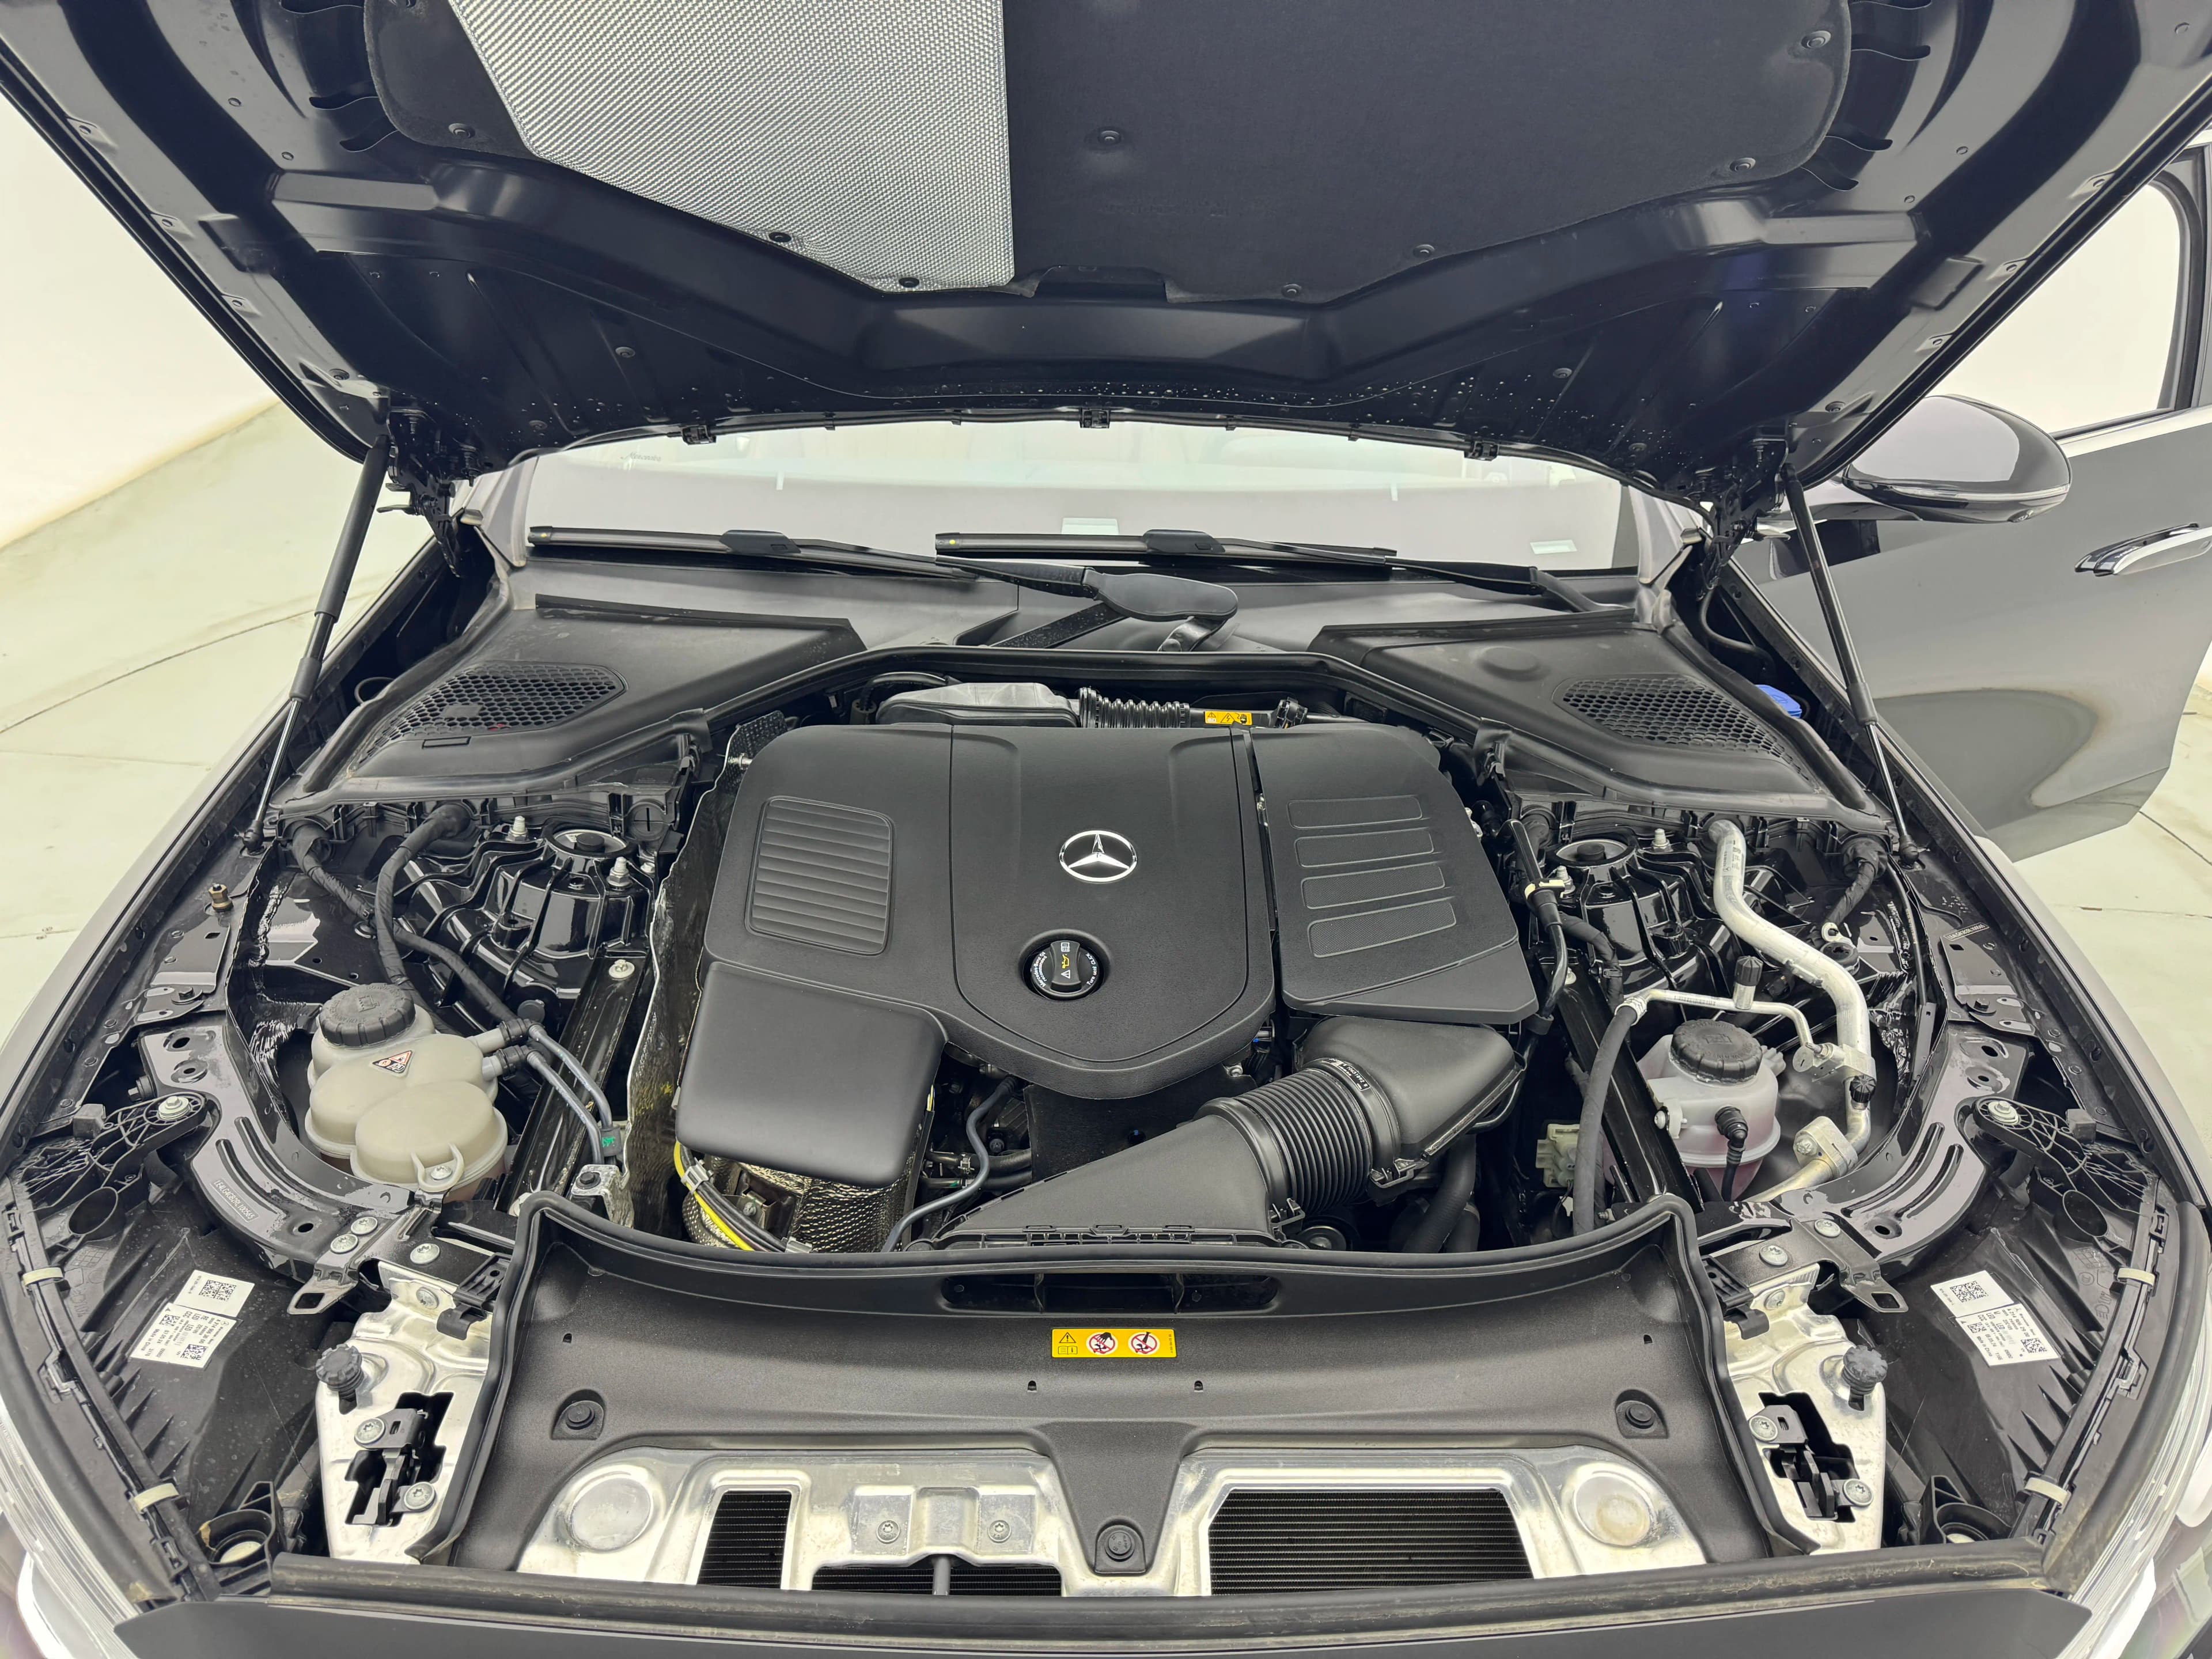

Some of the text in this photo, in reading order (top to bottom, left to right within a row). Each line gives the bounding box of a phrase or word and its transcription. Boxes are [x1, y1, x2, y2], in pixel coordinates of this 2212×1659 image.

[1033, 956, 1046, 987] Mercedes-Benz
[1039, 956, 1047, 982] recommended
[1085, 953, 1096, 965] CLICK
[1086, 976, 1096, 986] Turn
[214, 1180, 255, 1219] LE4LG4GB2RL100565
